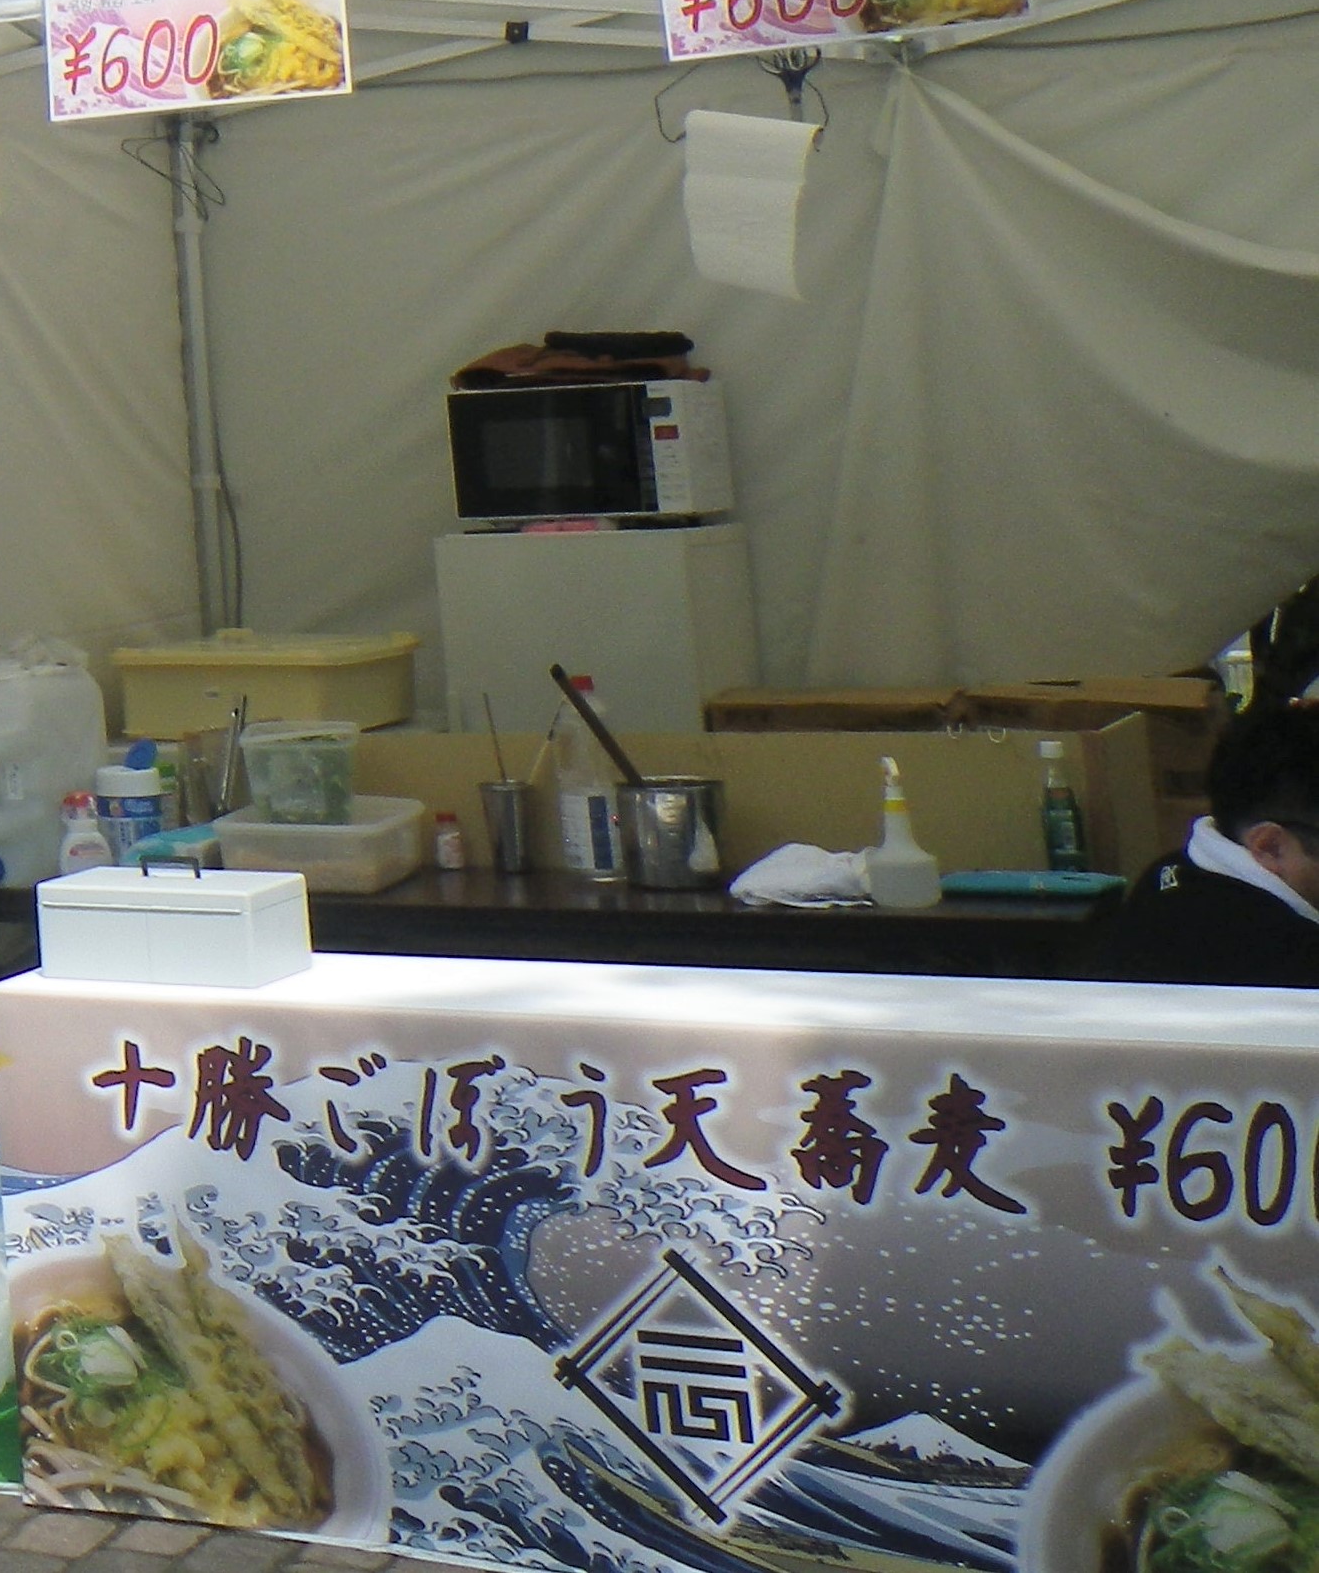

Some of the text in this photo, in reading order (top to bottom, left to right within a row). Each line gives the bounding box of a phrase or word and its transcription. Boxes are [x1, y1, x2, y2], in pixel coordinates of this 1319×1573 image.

[64, 13, 219, 96] ¥600
[92, 1035, 1319, 1226] 十勝ごぼう天蕎麦 ¥60
